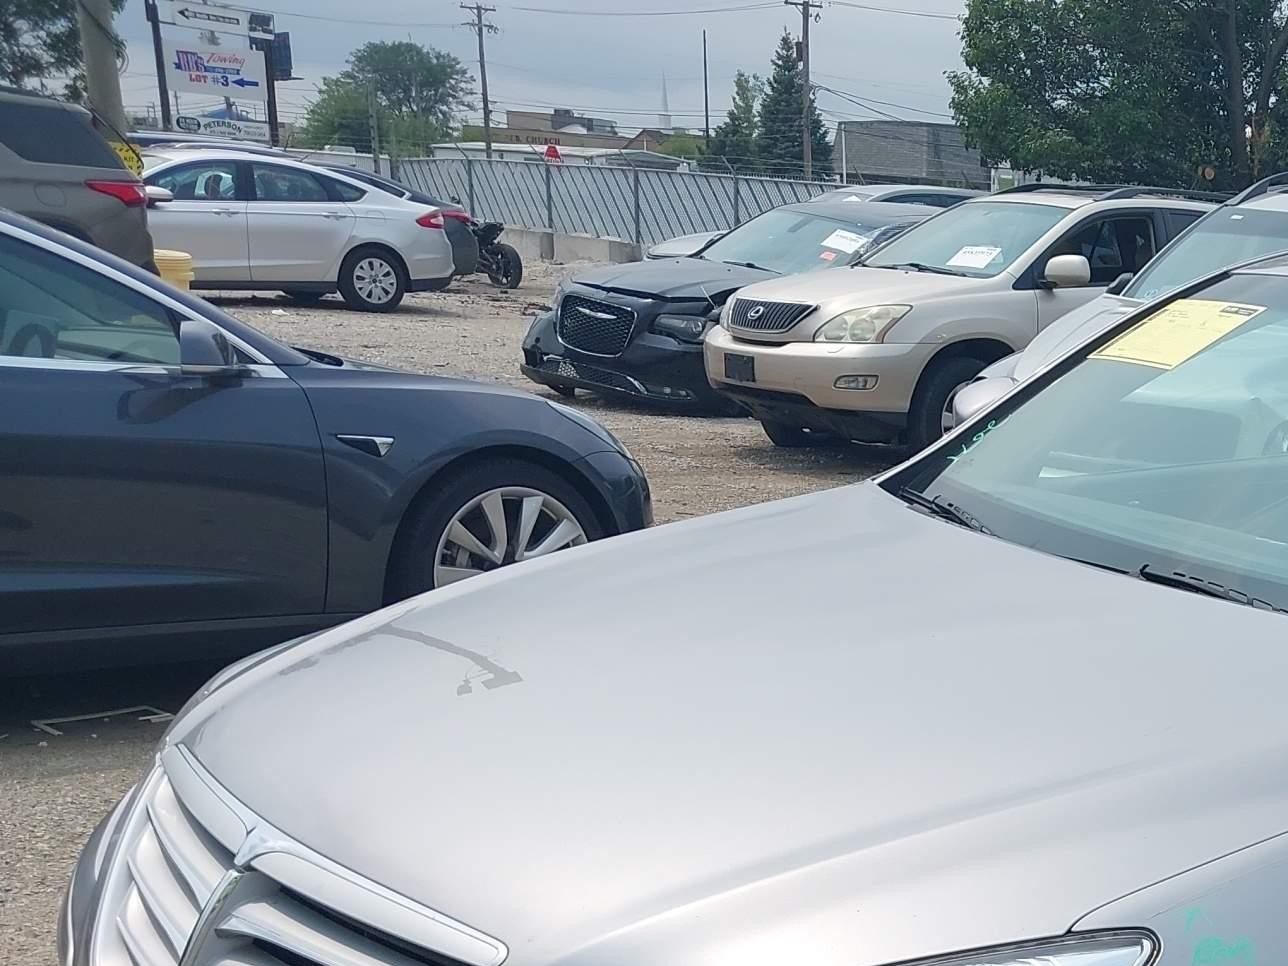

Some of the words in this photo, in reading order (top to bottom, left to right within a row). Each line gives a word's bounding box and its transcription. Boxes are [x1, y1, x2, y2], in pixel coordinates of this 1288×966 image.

[207, 52, 246, 69] Towing
[189, 74, 208, 84] LOT
[211, 75, 230, 87] #3
[203, 121, 243, 134] PETERSON
[526, 136, 560, 146] CHURCH
